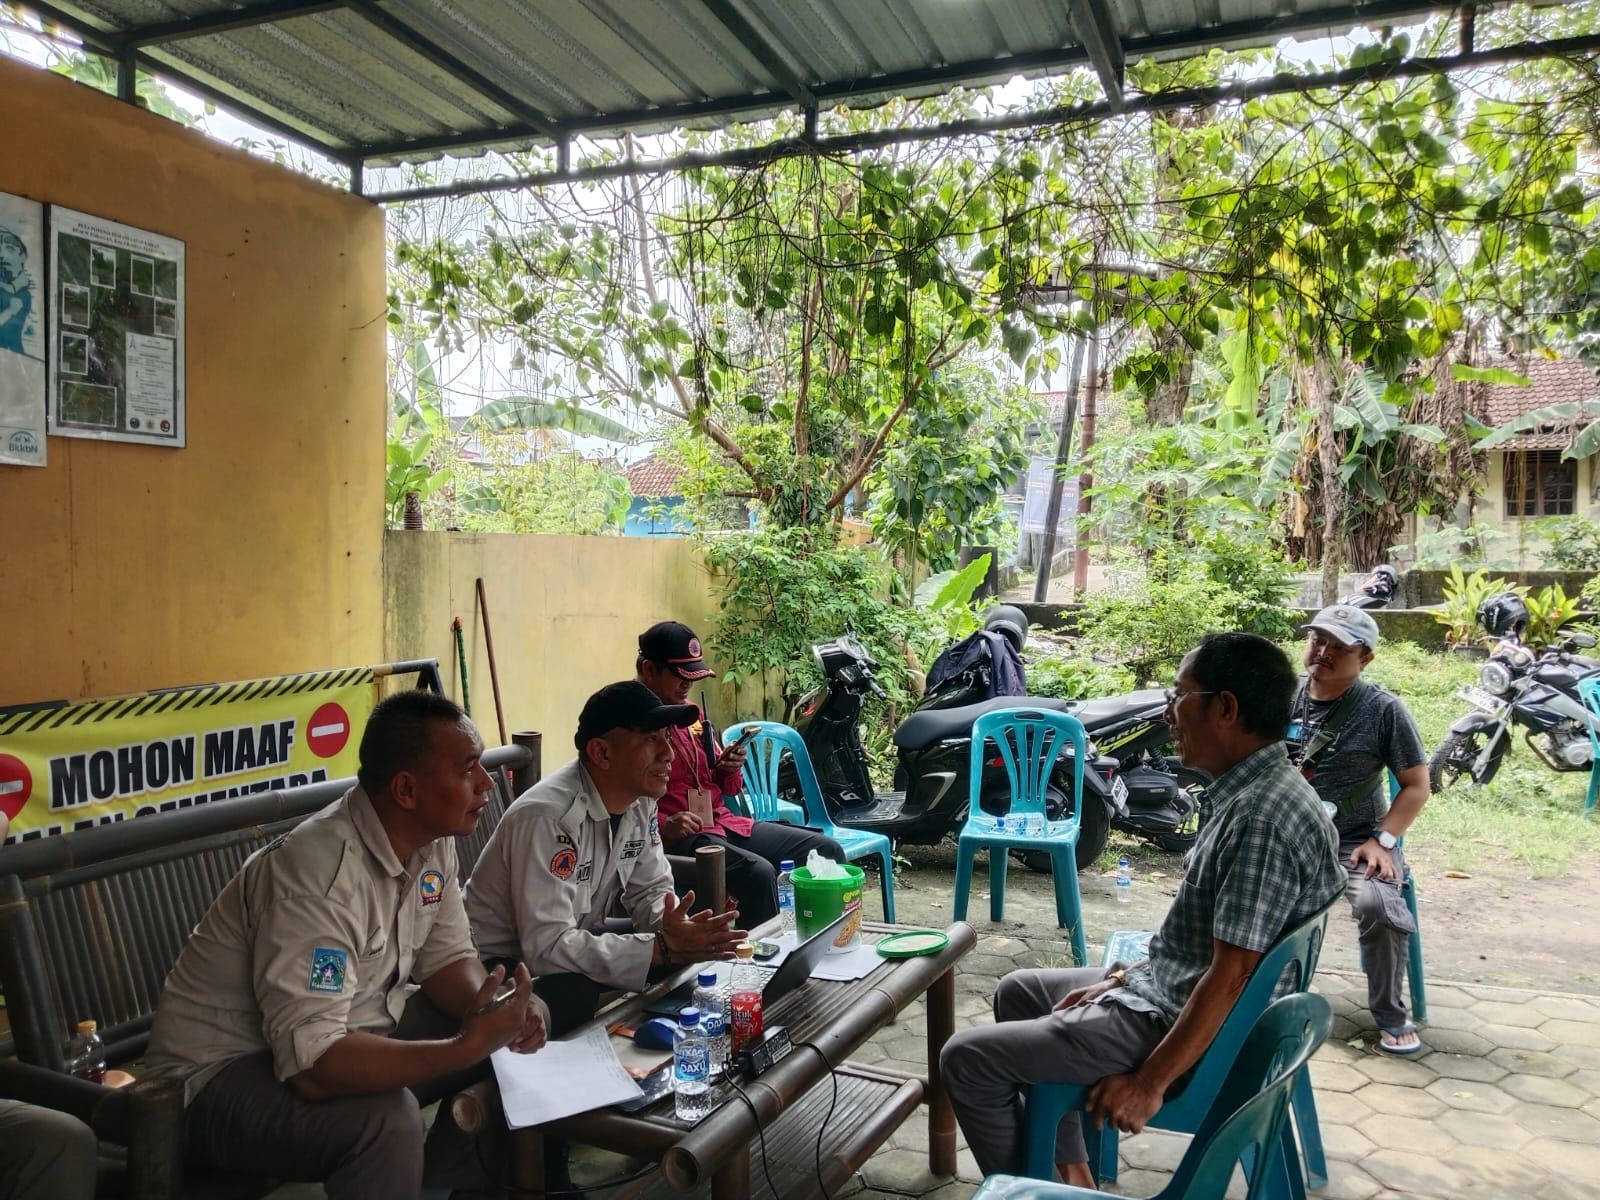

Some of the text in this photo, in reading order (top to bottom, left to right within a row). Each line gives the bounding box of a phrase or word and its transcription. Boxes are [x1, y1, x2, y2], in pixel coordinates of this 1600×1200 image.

[50, 720, 295, 809] MOHON MAAF
[680, 1061, 706, 1073] DAXU
